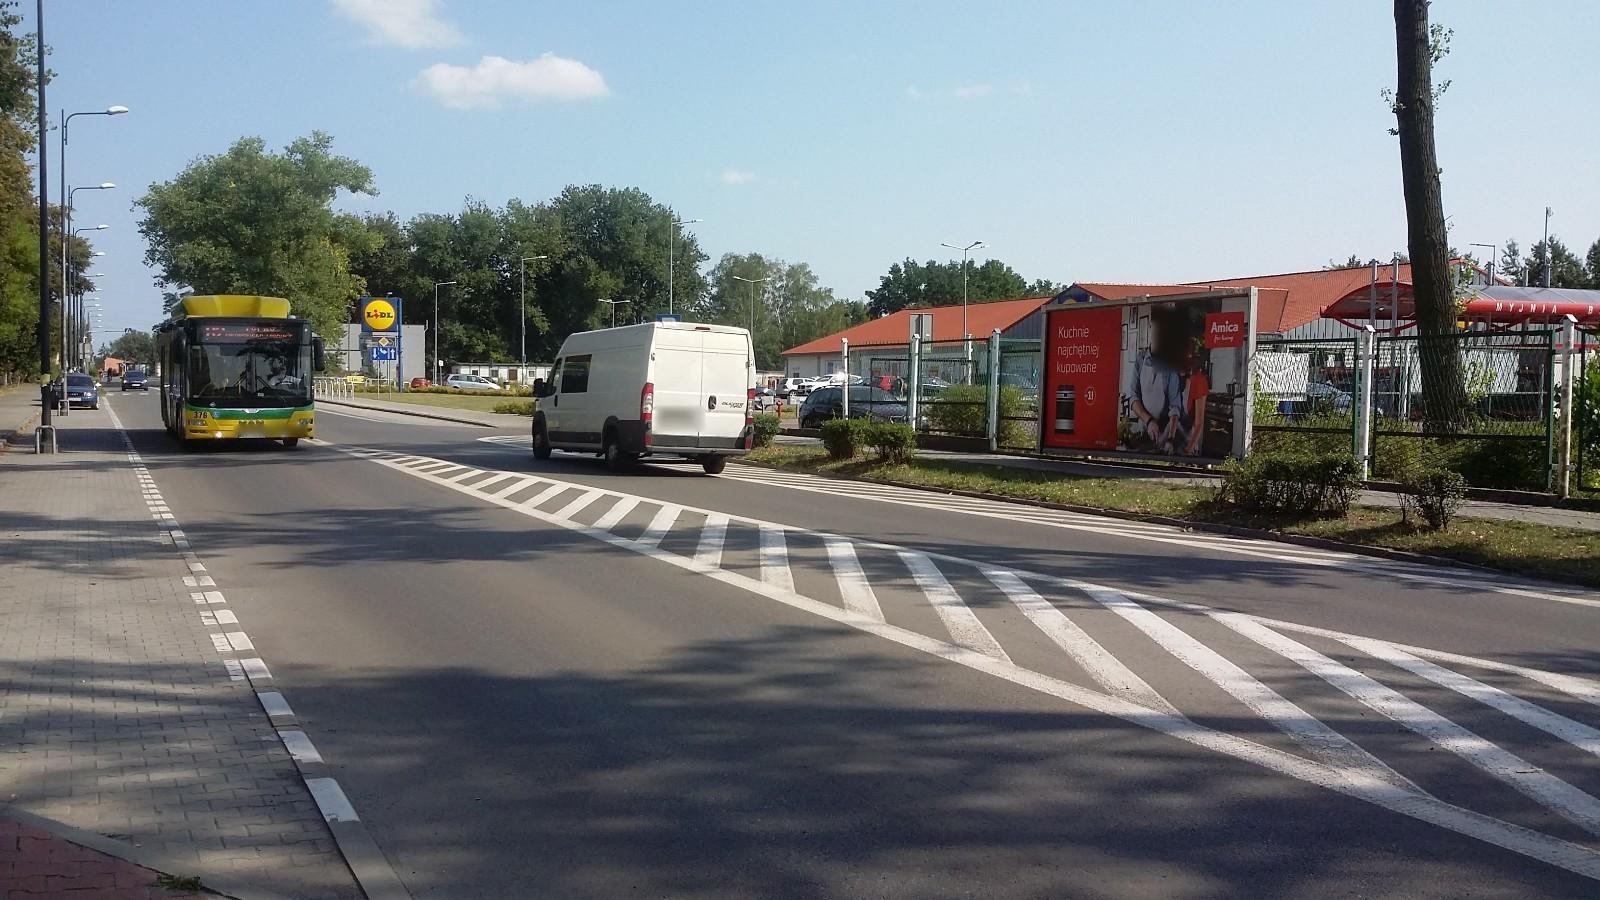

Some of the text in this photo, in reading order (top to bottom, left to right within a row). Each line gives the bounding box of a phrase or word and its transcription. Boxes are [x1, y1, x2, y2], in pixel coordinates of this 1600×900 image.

[1495, 302, 1557, 314] MYJNIA
[1058, 325, 1090, 339] Kuchnie
[1211, 320, 1239, 333] Amica
[1057, 342, 1100, 359] najchętniej
[1056, 361, 1097, 374] kupowane
